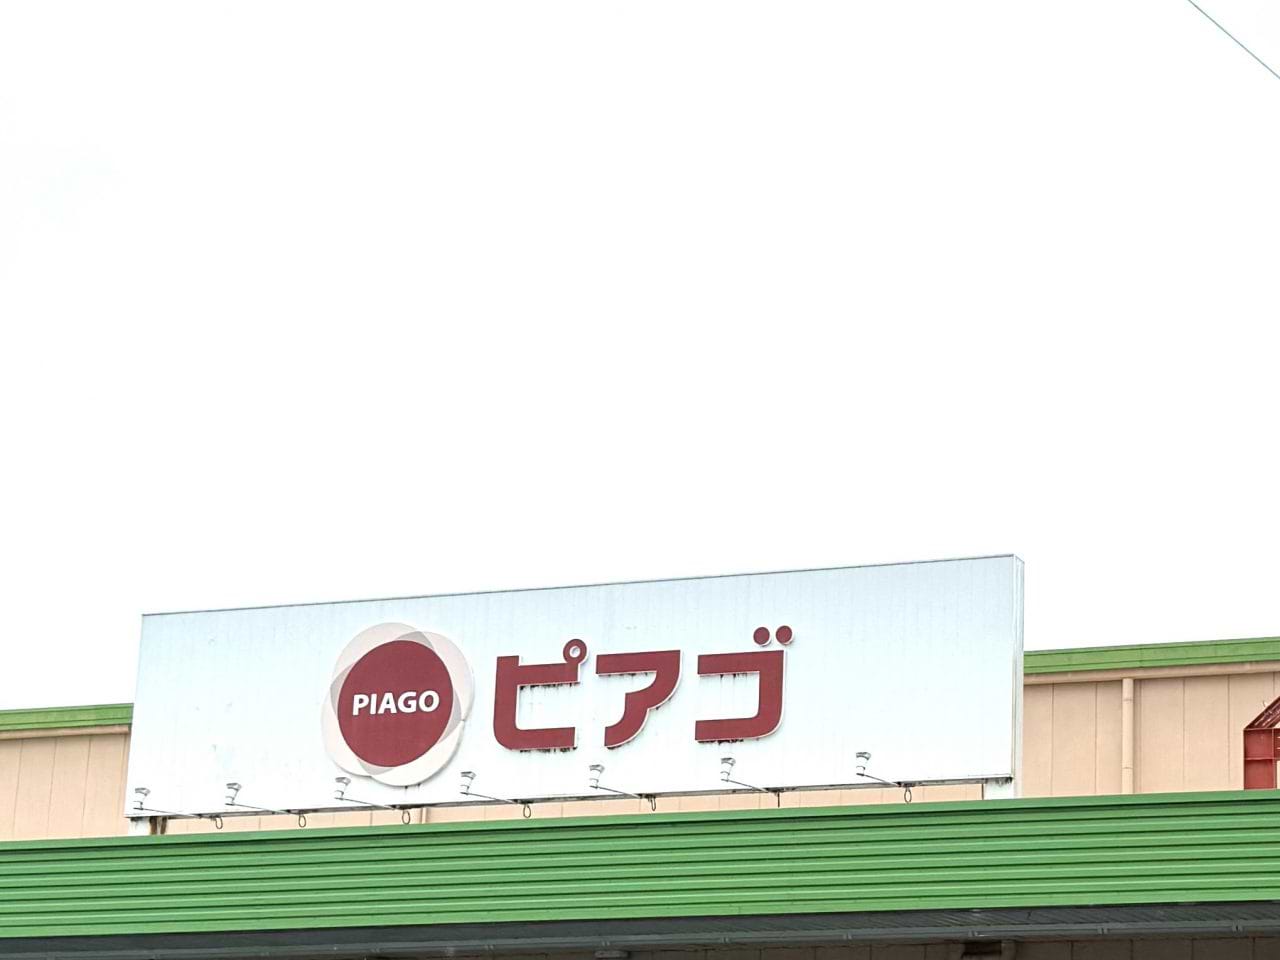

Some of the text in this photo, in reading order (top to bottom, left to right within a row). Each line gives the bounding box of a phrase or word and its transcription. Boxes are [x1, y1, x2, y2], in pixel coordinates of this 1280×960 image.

[352, 690, 440, 716] PIAGO
[494, 625, 795, 751] ピアゴ
